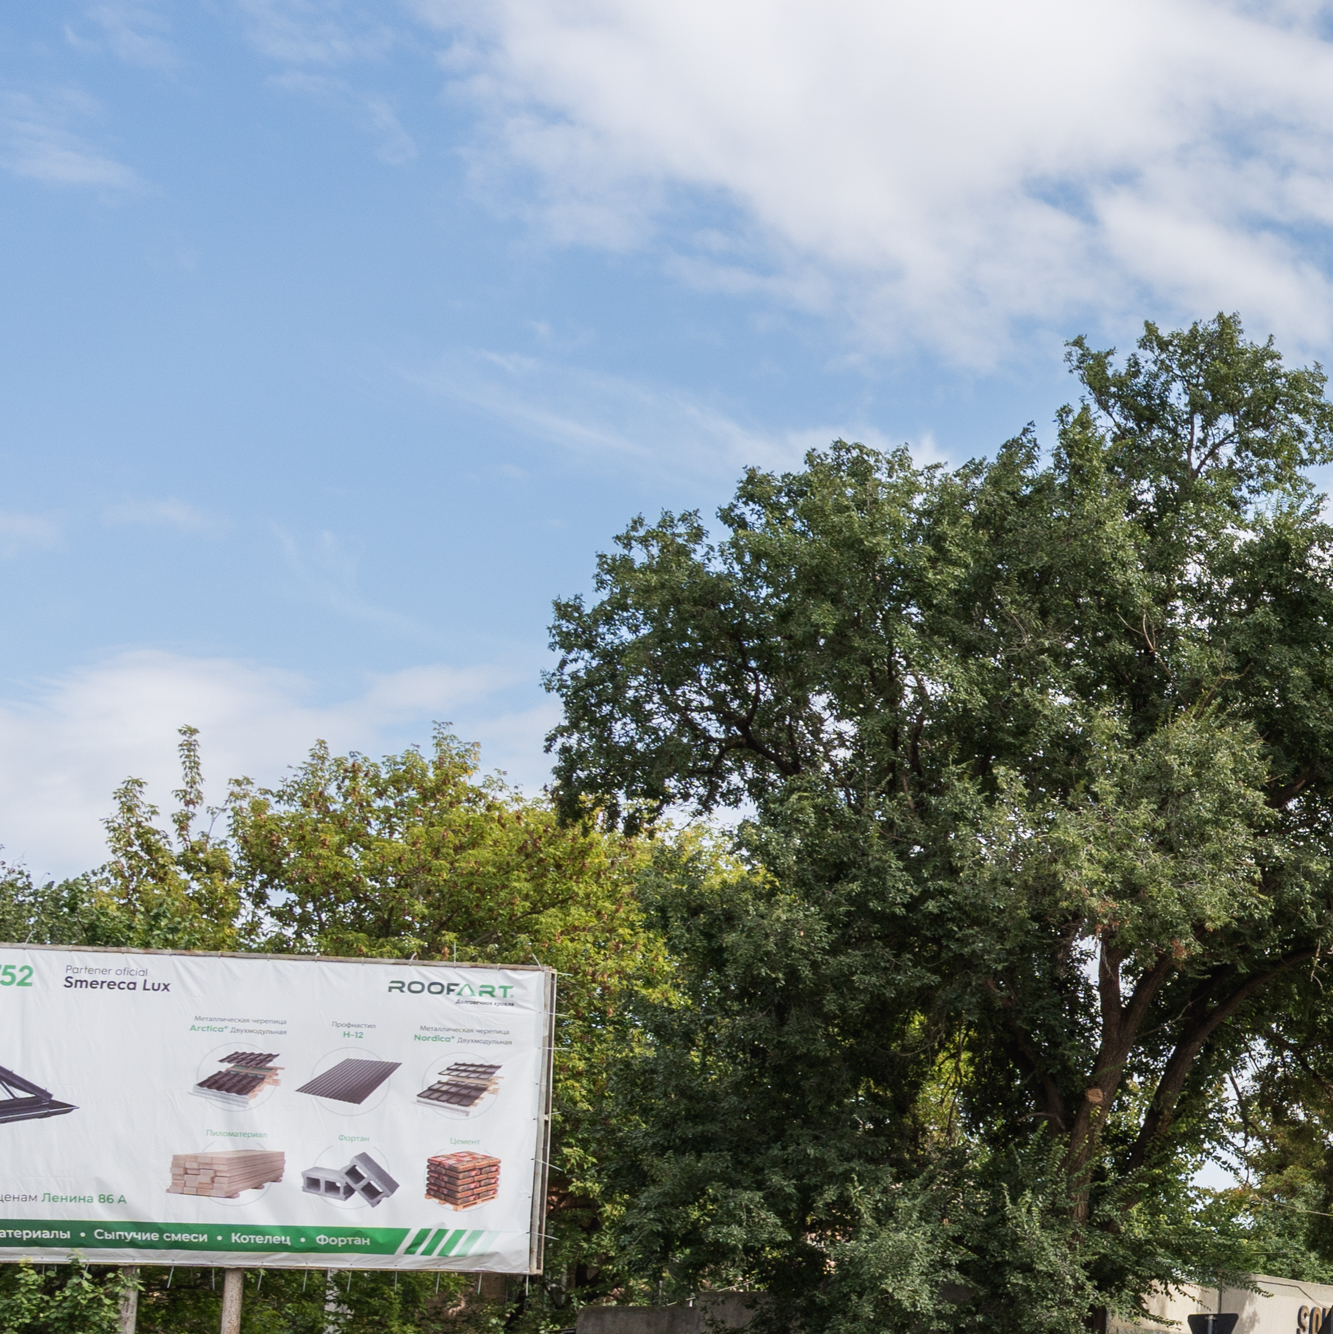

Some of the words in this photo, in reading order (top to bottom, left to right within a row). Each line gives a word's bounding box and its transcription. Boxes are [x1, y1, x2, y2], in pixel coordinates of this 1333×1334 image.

[0, 965, 34, 987] 52
[65, 964, 112, 976] Partener
[115, 966, 148, 977] oficial
[63, 976, 137, 991] Smereca
[142, 978, 171, 993] Lux
[331, 1020, 377, 1030] Профнастил
[206, 1129, 268, 1139] Пиломатериал
[41, 1192, 94, 1204] Ленина
[98, 1194, 114, 1204] 86
[117, 1194, 127, 1204] А
[94, 1228, 160, 1242] Сыпучие
[163, 1231, 208, 1242] смеси
[231, 1233, 291, 1246] Котелец
[316, 1234, 371, 1247] Фортан
